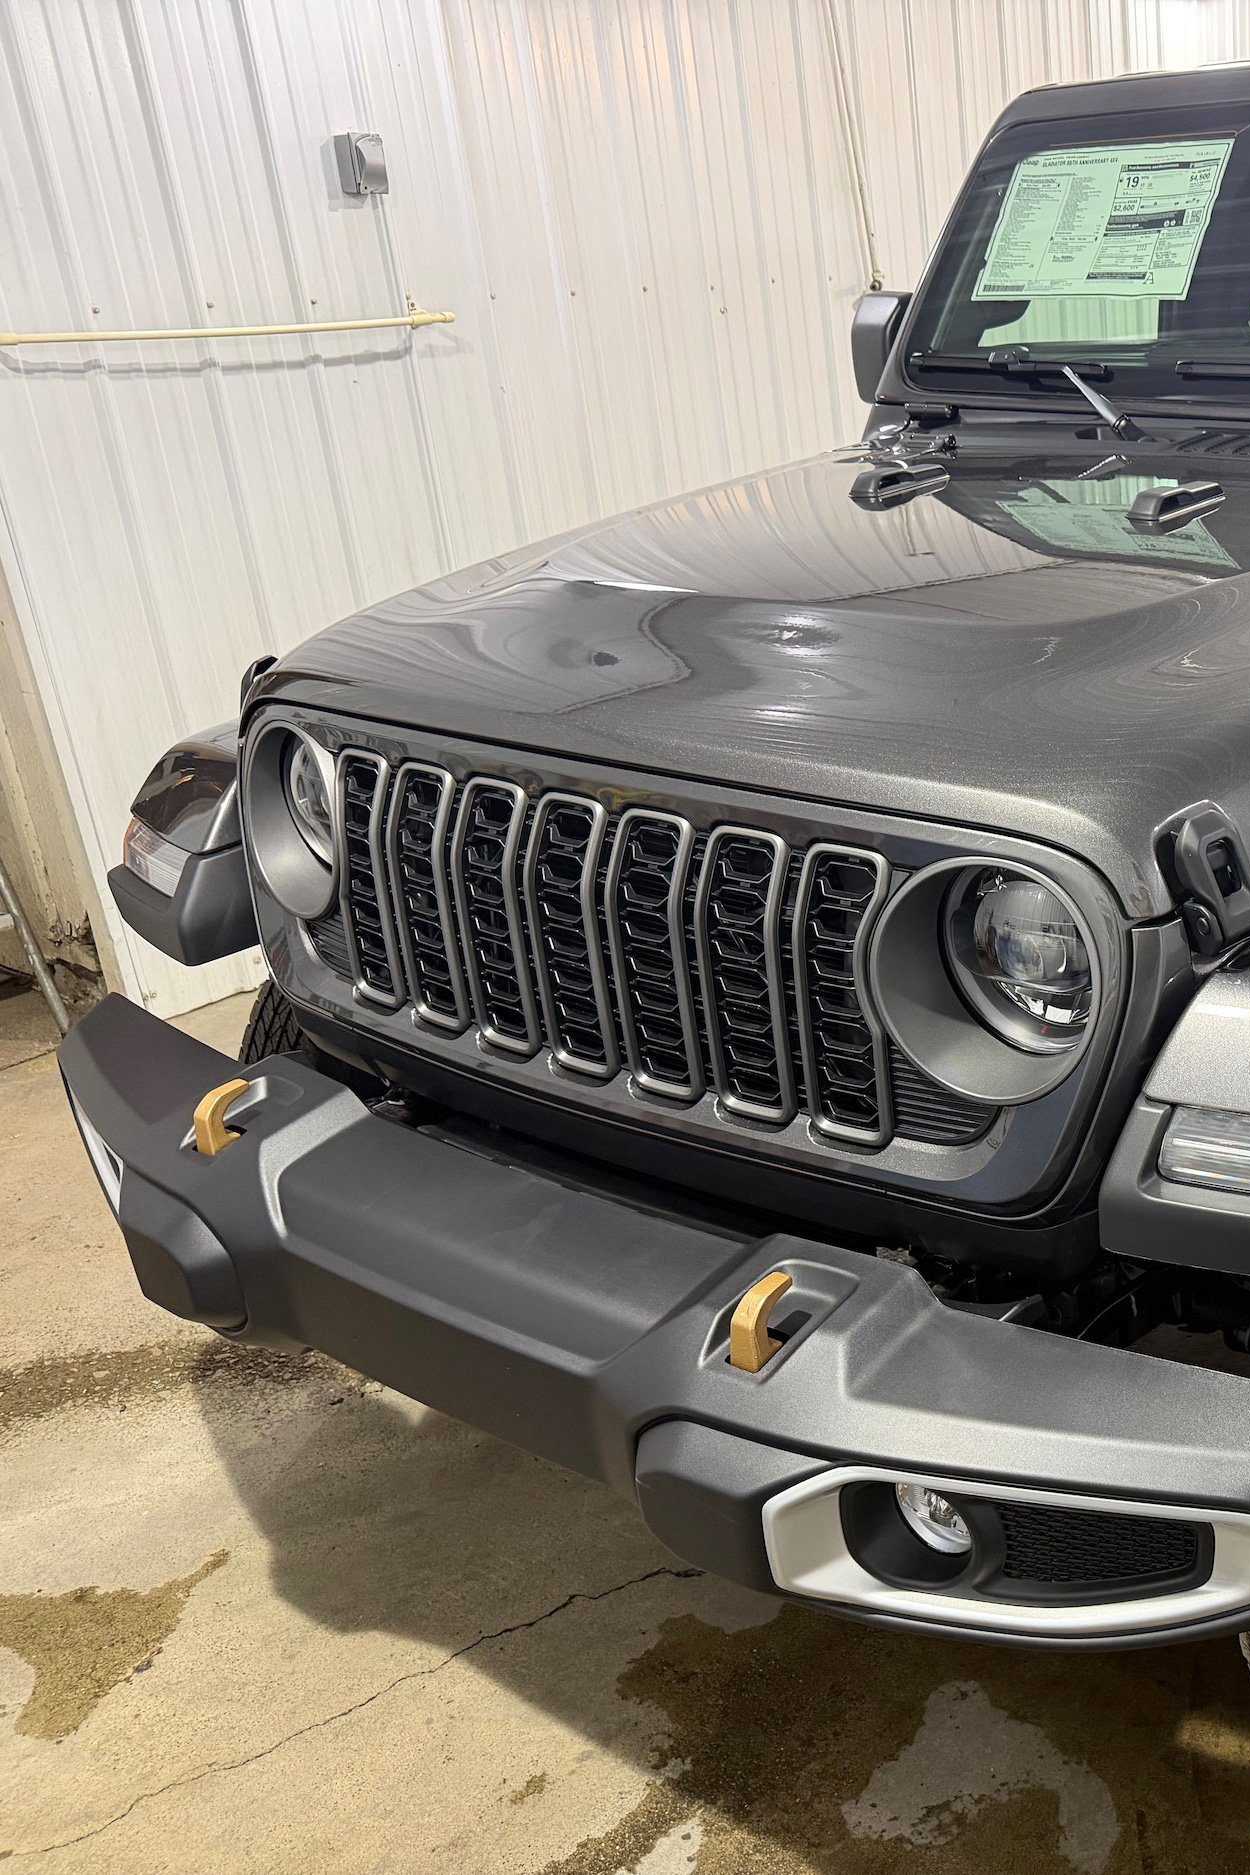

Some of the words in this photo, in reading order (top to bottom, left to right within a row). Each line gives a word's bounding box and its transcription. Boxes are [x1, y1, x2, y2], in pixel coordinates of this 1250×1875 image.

[1042, 160, 1066, 168] GLADIATOR
[1190, 173, 1210, 182] $4,500
[1125, 176, 1140, 188] 19
[1113, 204, 1135, 212] $2,600
